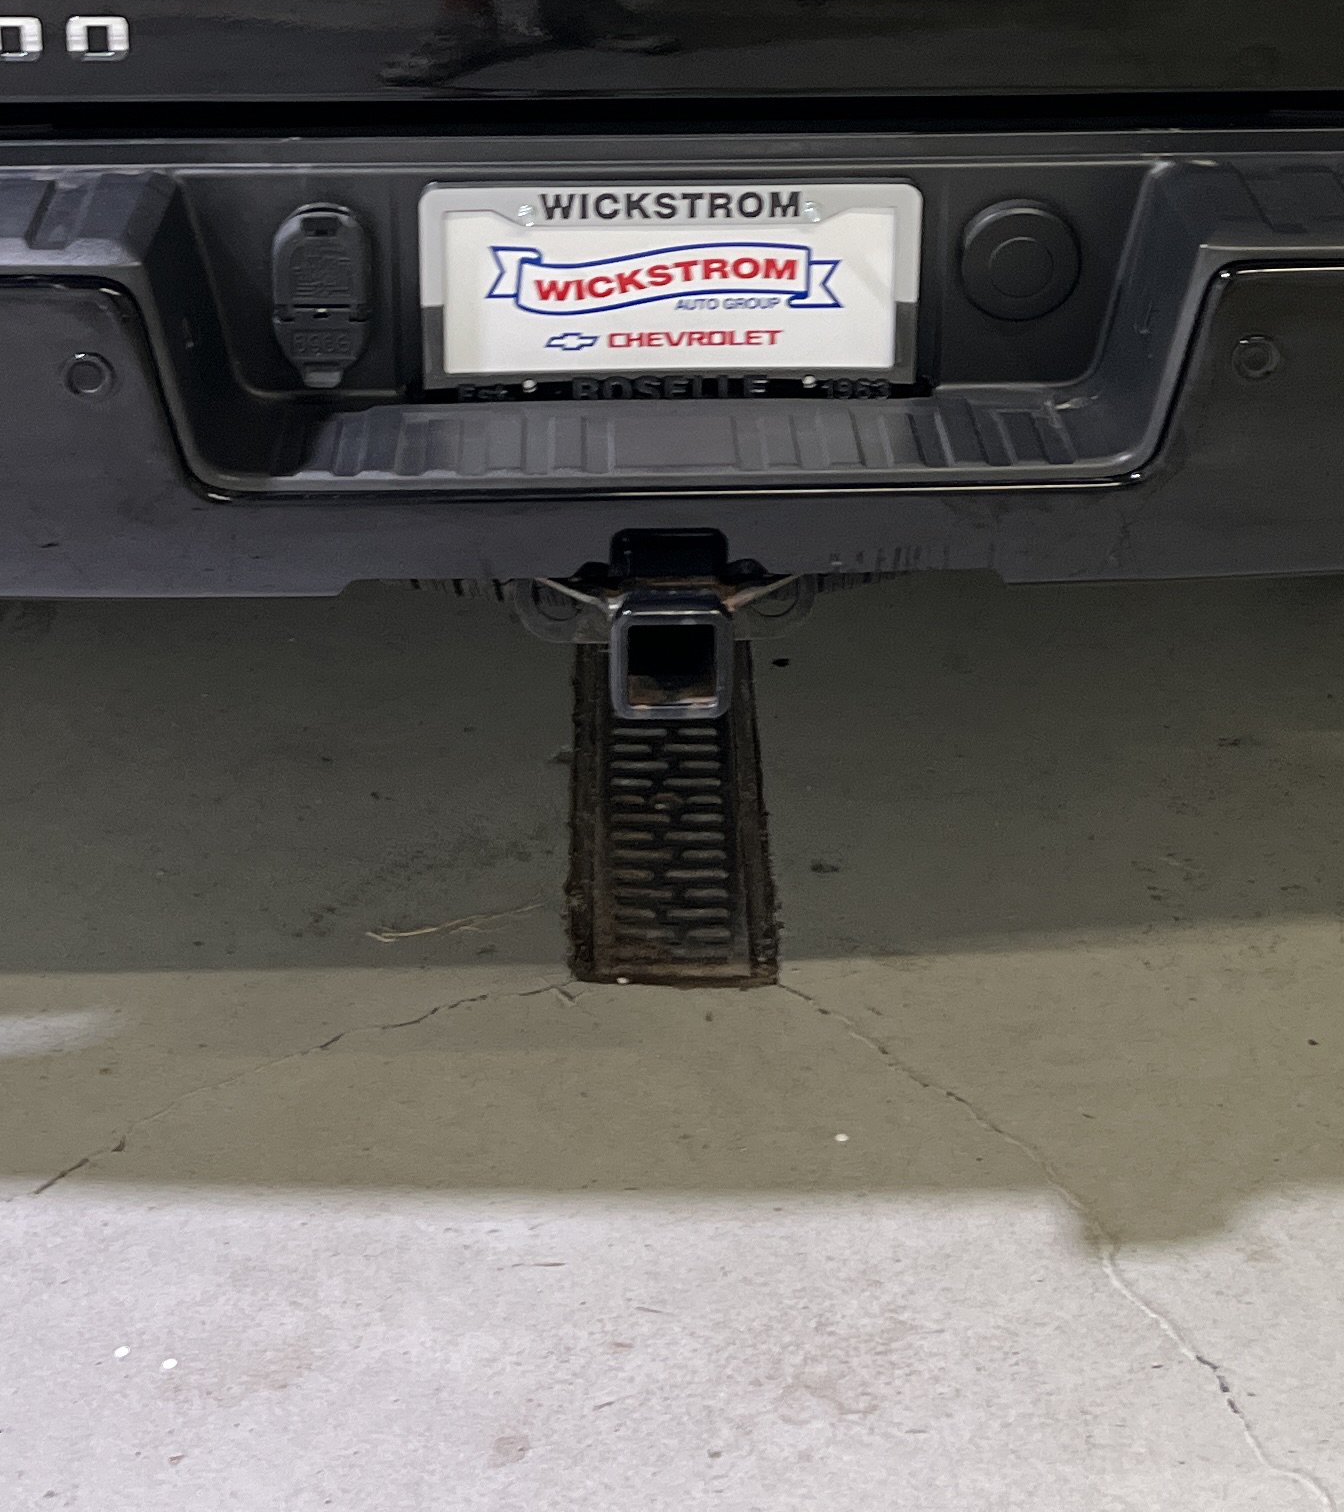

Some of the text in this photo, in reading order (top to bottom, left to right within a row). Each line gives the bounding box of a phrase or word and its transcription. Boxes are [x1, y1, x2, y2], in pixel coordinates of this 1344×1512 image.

[539, 190, 802, 221] WICKSTROM
[534, 257, 798, 302] WICKSTROM
[674, 295, 781, 312] AUTO GROUP
[606, 329, 784, 349] CHEVROLET
[572, 375, 769, 401] ROSELLE
